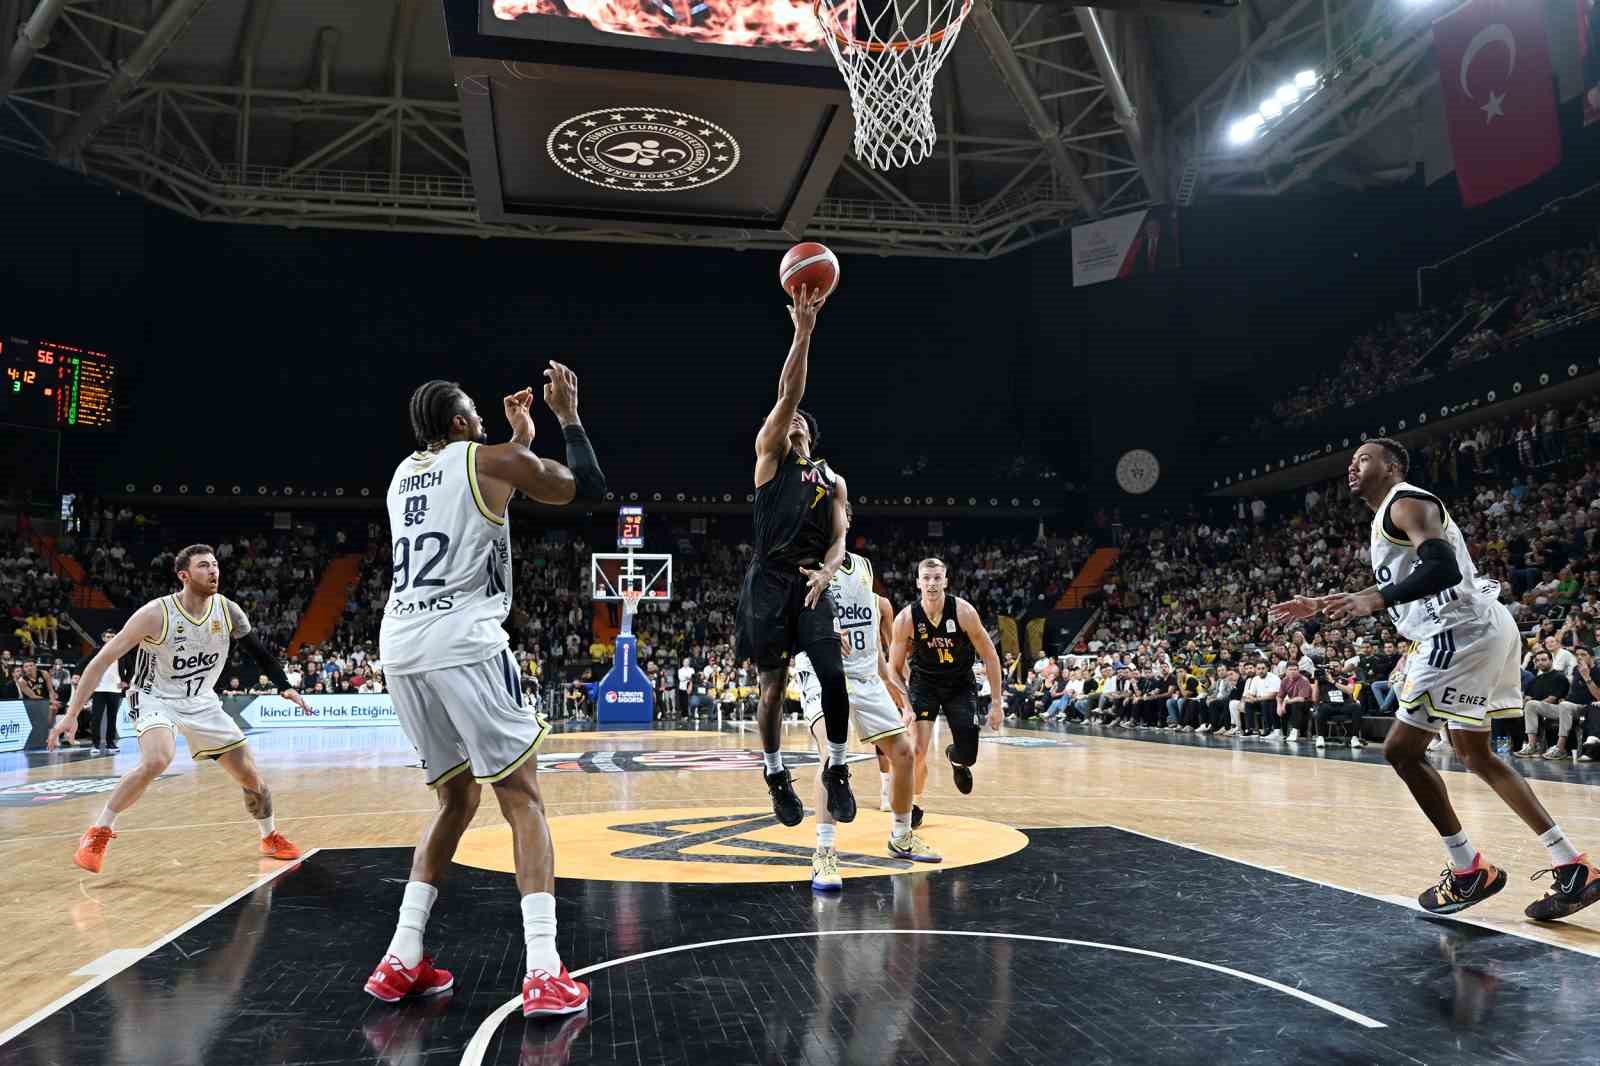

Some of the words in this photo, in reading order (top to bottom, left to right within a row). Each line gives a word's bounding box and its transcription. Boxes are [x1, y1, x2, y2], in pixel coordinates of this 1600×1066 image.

[37, 350, 54, 365] 56
[7, 367, 36, 384] 4:12
[13, 381, 21, 392] 3
[399, 470, 443, 495] BIRCH
[809, 486, 826, 509] 7
[623, 524, 640, 538] 27
[393, 531, 450, 594] 92
[836, 602, 872, 620] beko
[848, 631, 865, 650] 18
[173, 652, 219, 670] beko
[937, 648, 954, 664] 14
[184, 677, 204, 697] 17
[1459, 693, 1488, 706] ENEZ
[260, 705, 291, 717] İkinci
[323, 705, 347, 717] Hak
